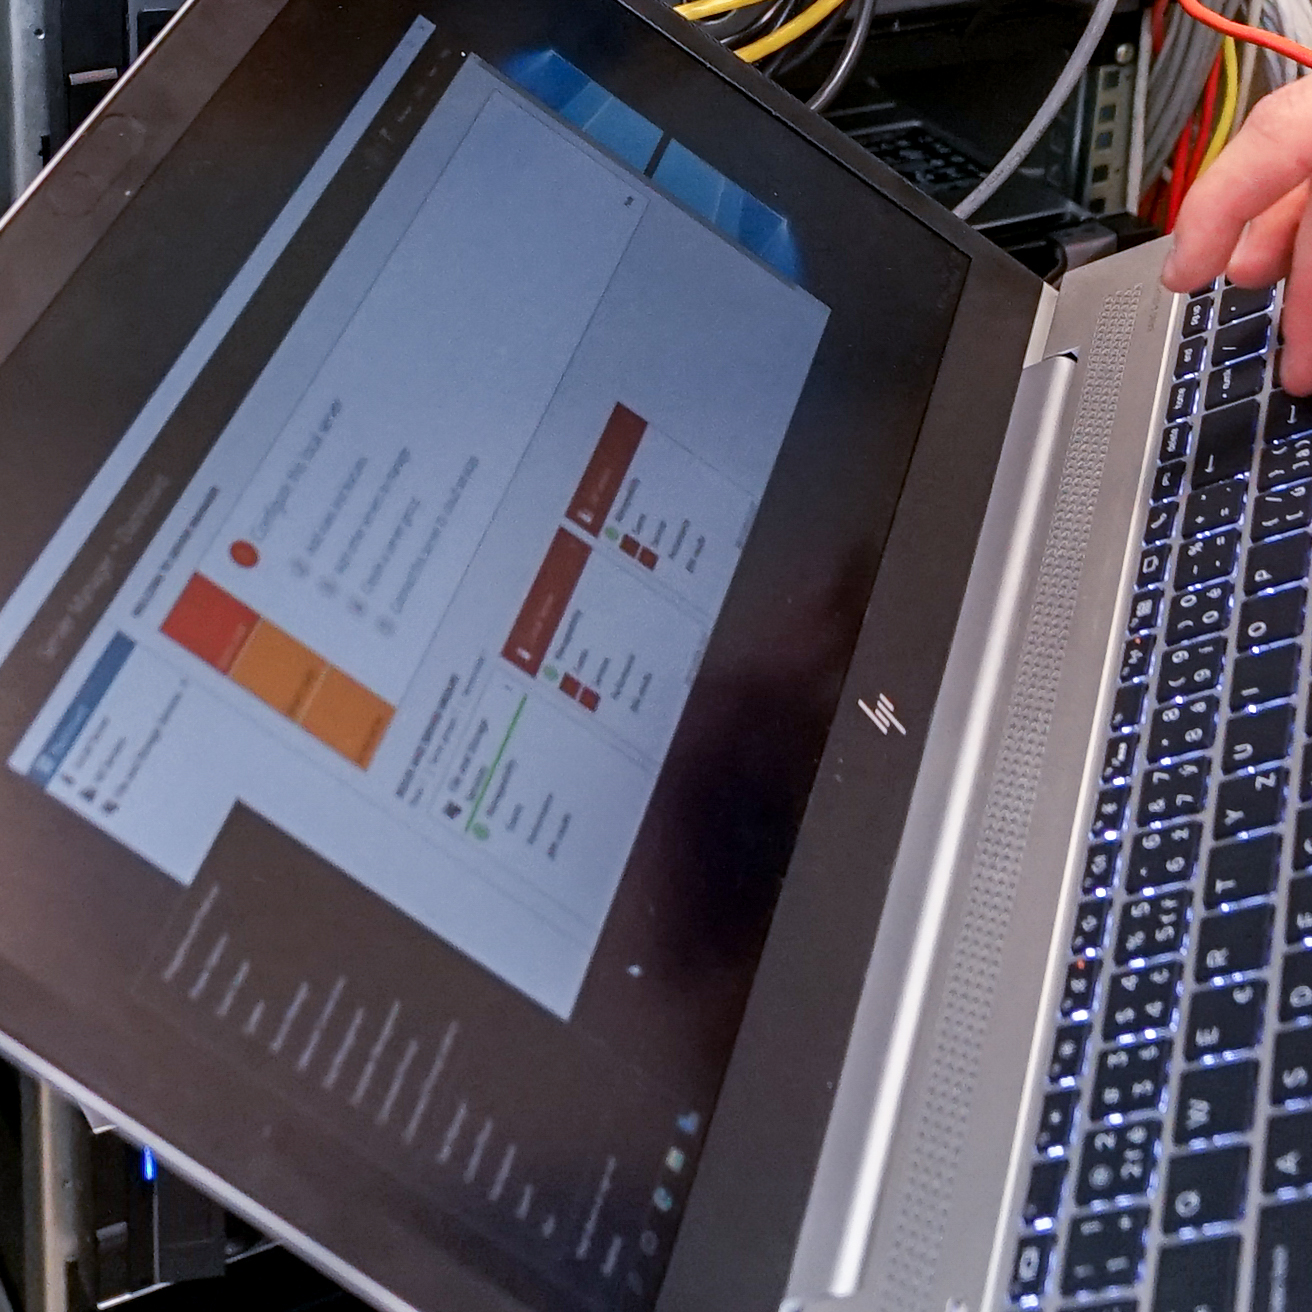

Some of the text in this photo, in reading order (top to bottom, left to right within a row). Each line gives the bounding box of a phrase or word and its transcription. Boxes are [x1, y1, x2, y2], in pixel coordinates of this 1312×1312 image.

[1183, 348, 1194, 362] end
[1173, 387, 1186, 409] home
[1167, 427, 1179, 452] delete
[1254, 569, 1273, 582] P
[1248, 621, 1267, 637] O
[1172, 650, 1189, 663] 9
[1194, 668, 1212, 682] 9
[1240, 687, 1260, 697] I
[1162, 707, 1180, 722] 8
[1184, 728, 1203, 742] 8
[1233, 743, 1253, 761] U
[1152, 771, 1170, 784] 7
[1255, 772, 1276, 791] Z
[1175, 793, 1194, 807] 7
[1224, 809, 1245, 826] Y
[1142, 833, 1161, 849] 6
[1166, 856, 1185, 872] 6
[1214, 878, 1237, 894] T
[1131, 901, 1151, 918] 5
[1155, 925, 1175, 942] 5
[1206, 947, 1229, 969] R
[1121, 974, 1138, 991] 4
[1148, 1000, 1164, 1018] 4
[1195, 1026, 1220, 1047] E
[1107, 1050, 1129, 1069] 3
[1281, 1065, 1308, 1089] S
[1132, 1079, 1154, 1099] 3
[1186, 1098, 1211, 1130] W
[1094, 1132, 1118, 1152] 2
[1275, 1149, 1301, 1175] A
[1174, 1189, 1201, 1218] Q
